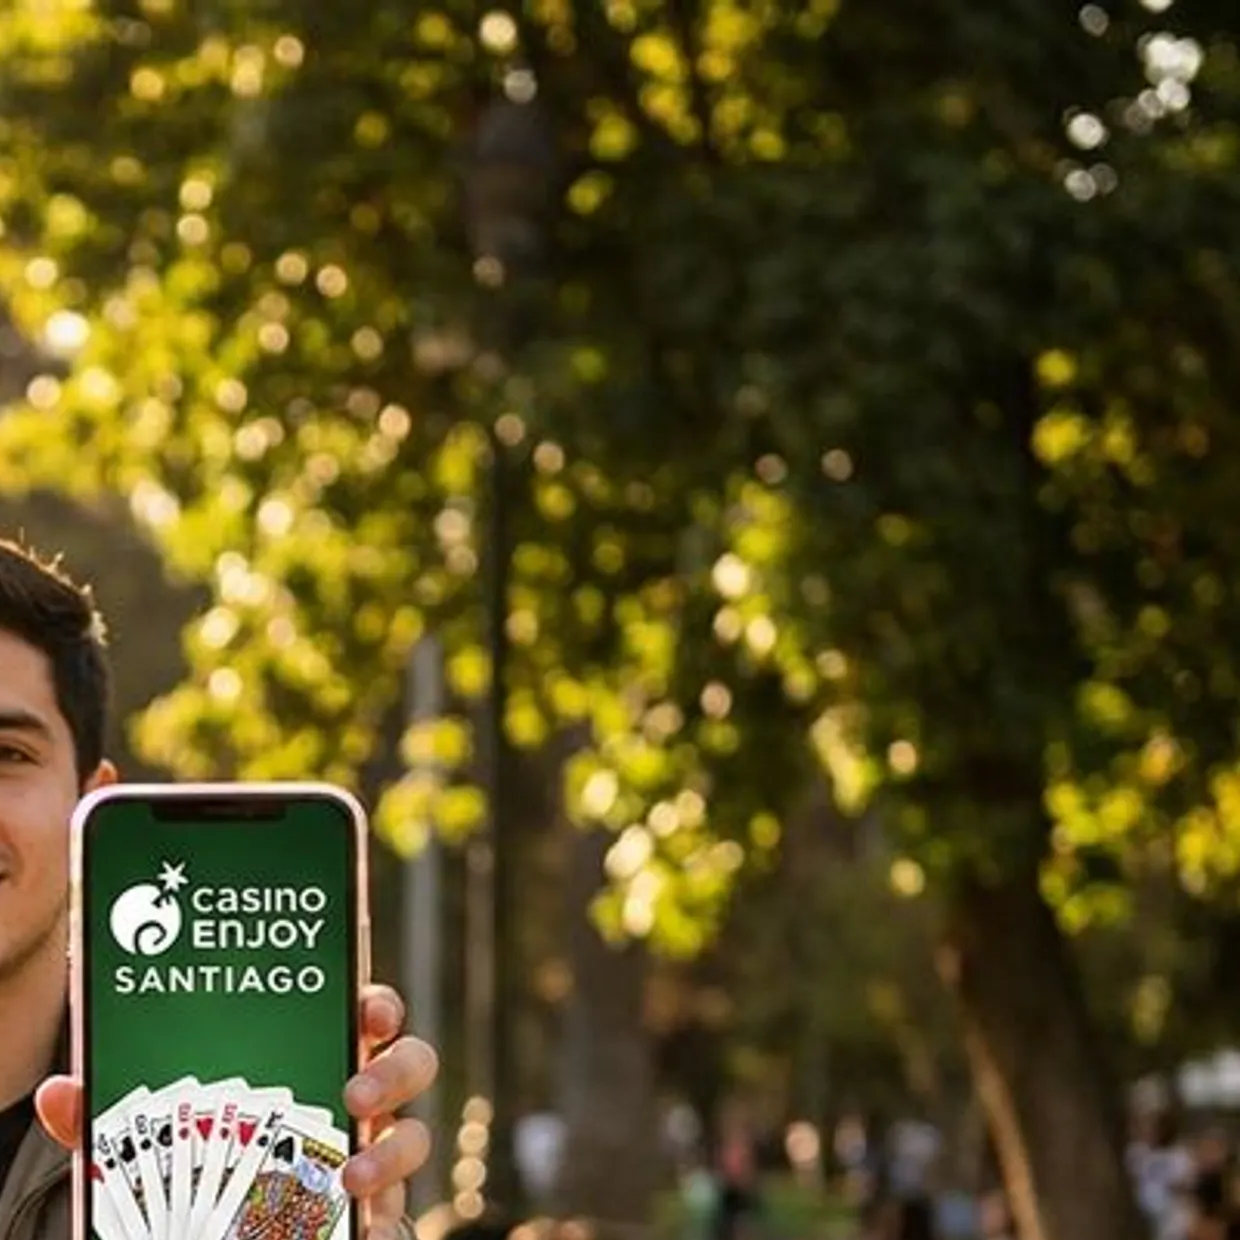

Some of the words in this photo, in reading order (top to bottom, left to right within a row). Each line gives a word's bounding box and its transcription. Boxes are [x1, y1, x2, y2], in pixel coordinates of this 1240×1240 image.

[192, 887, 326, 913] casino
[193, 919, 325, 949] ENJOY
[115, 965, 325, 994] SANTIAGO
